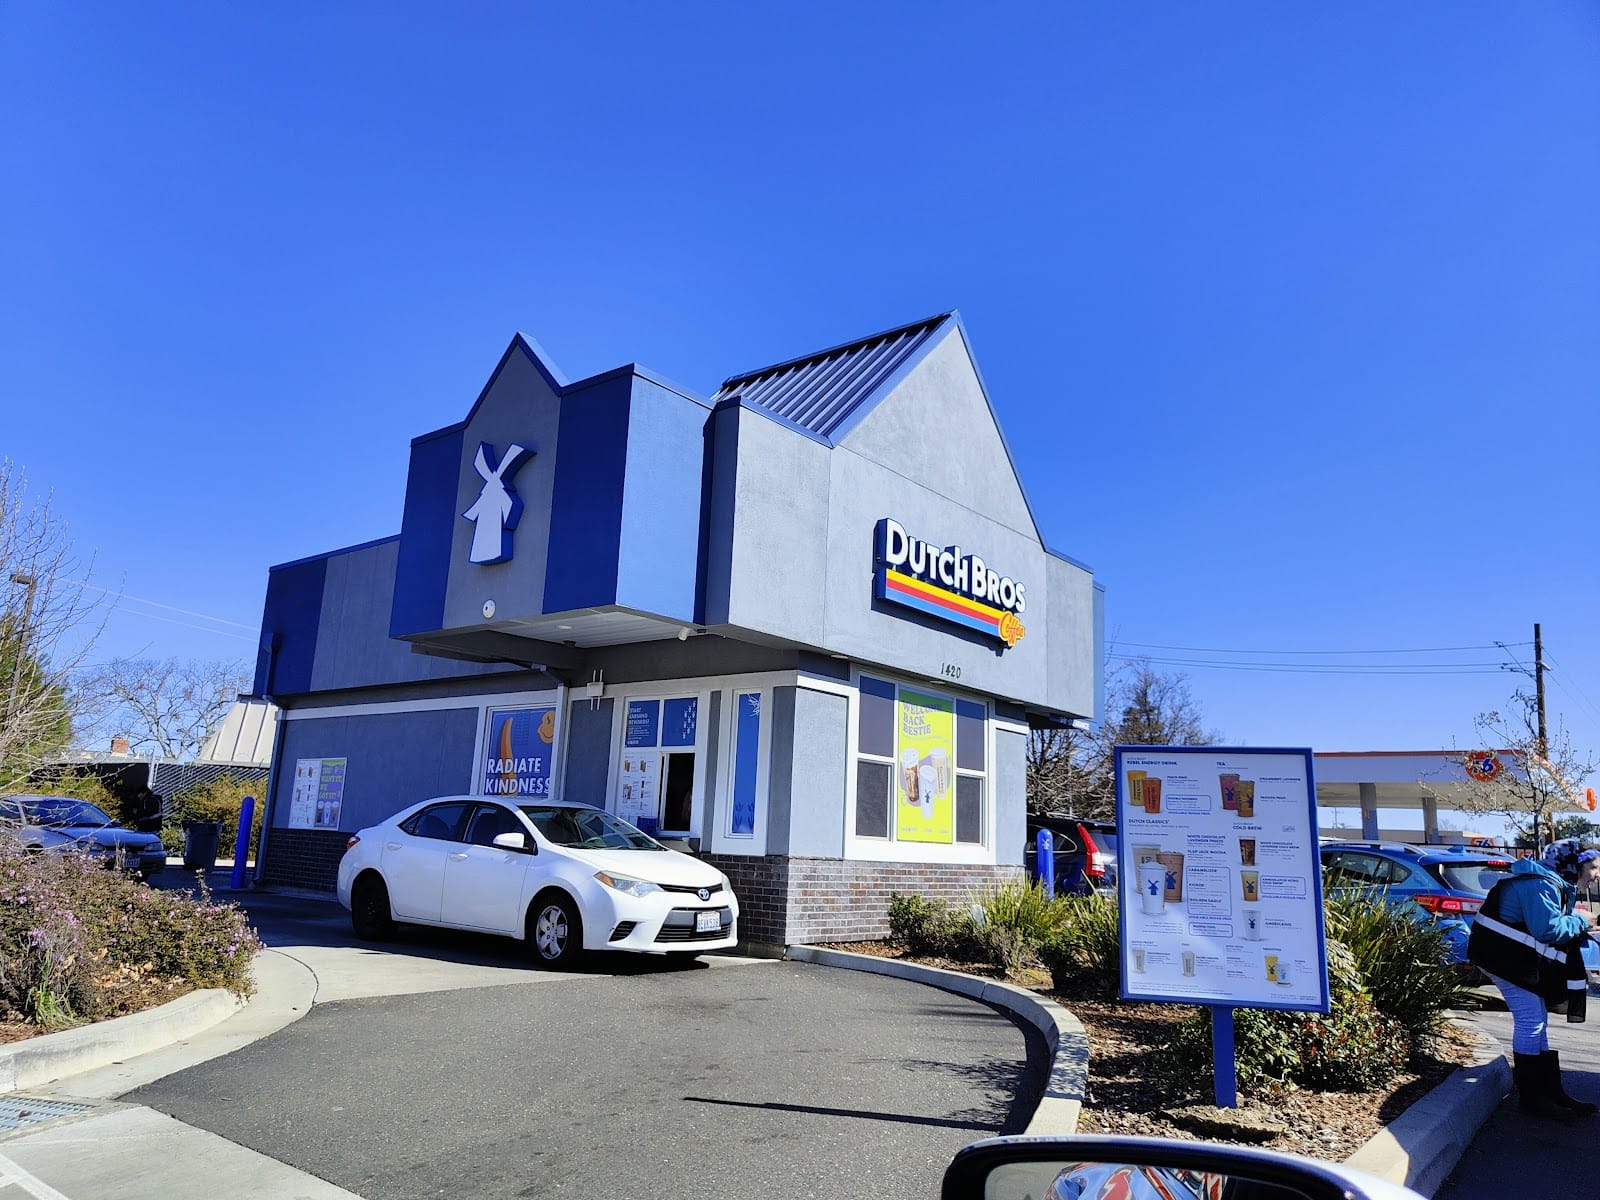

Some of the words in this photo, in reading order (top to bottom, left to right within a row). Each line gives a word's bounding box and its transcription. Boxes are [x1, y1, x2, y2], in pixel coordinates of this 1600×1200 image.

[886, 518, 968, 592] DUTCH
[972, 556, 1026, 613] BROS
[940, 662, 962, 679] 1420
[903, 712, 924, 726] BACK
[903, 723, 931, 736] BESTIE
[487, 757, 541, 774] RADIATE
[485, 778, 550, 794] KINDNESS
